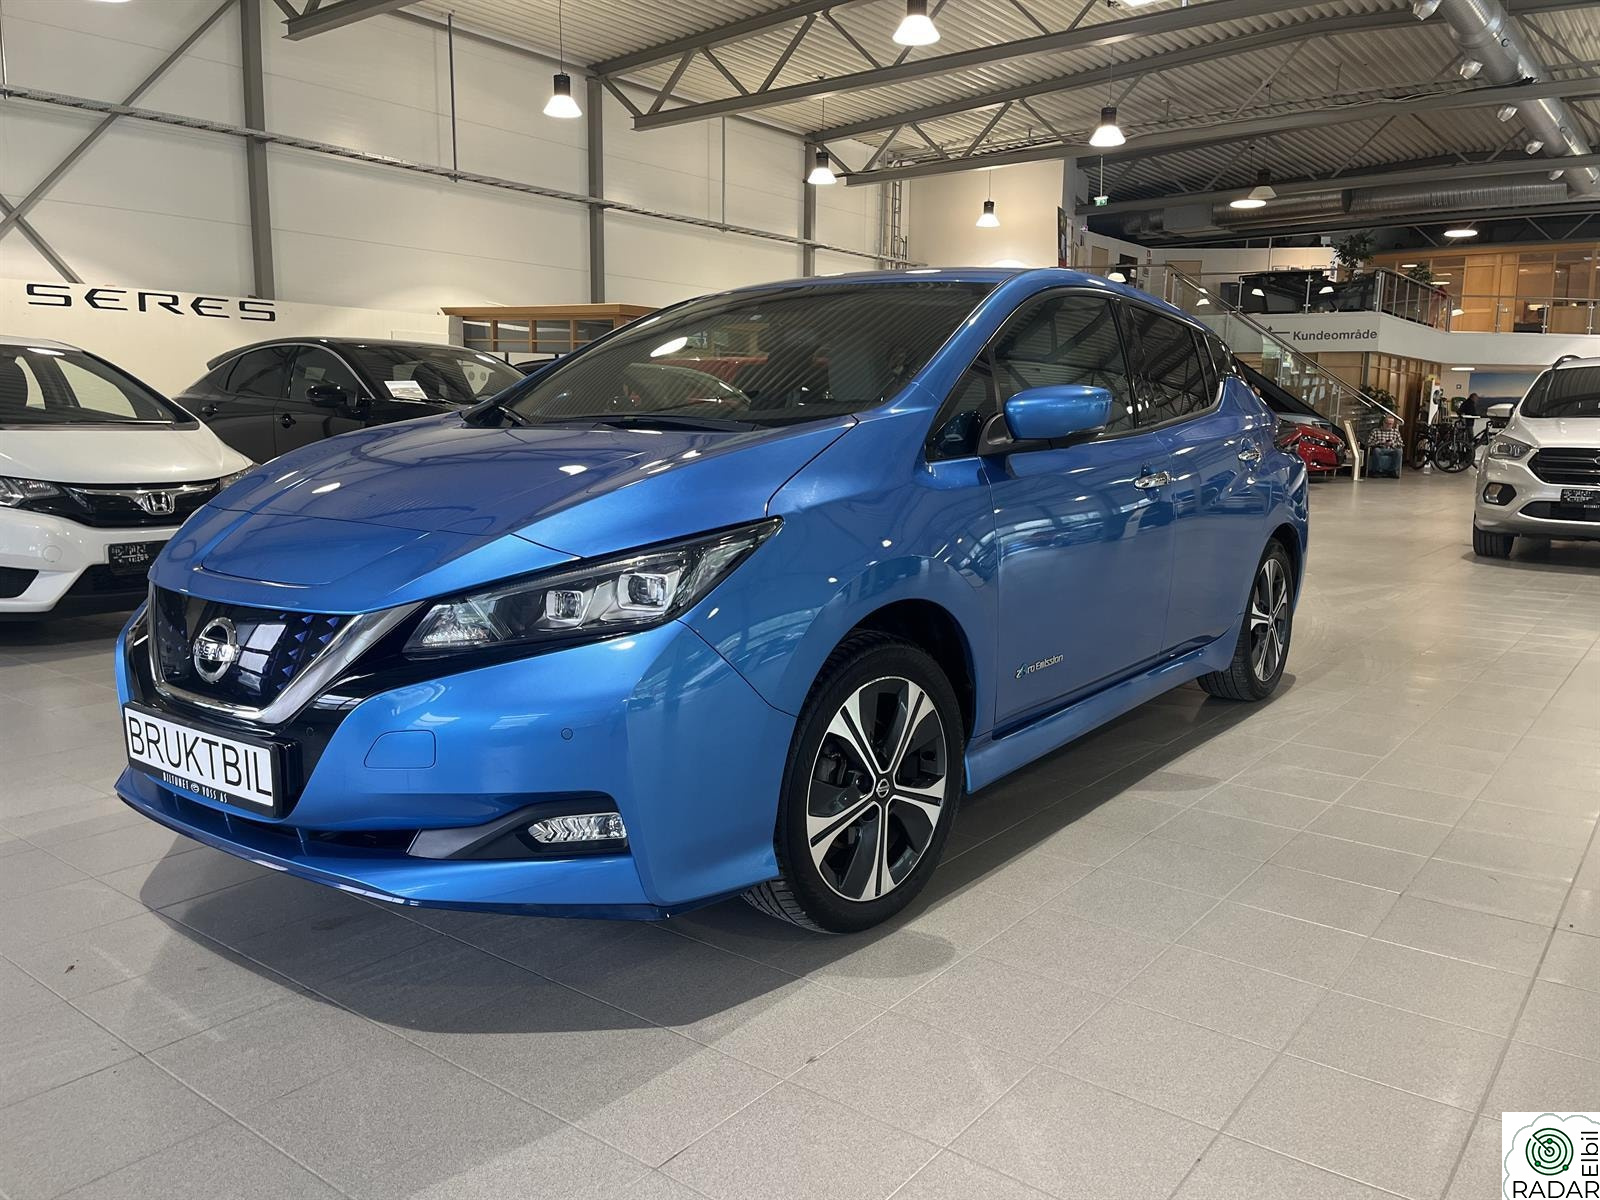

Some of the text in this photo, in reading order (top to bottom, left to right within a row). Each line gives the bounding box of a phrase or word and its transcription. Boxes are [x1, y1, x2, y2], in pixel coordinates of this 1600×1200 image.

[26, 283, 275, 322] SERES
[1292, 329, 1378, 341] Kundeområde
[128, 716, 272, 797] BRUKTBIL
[201, 786, 217, 800] VOSS
[219, 791, 228, 804] AS
